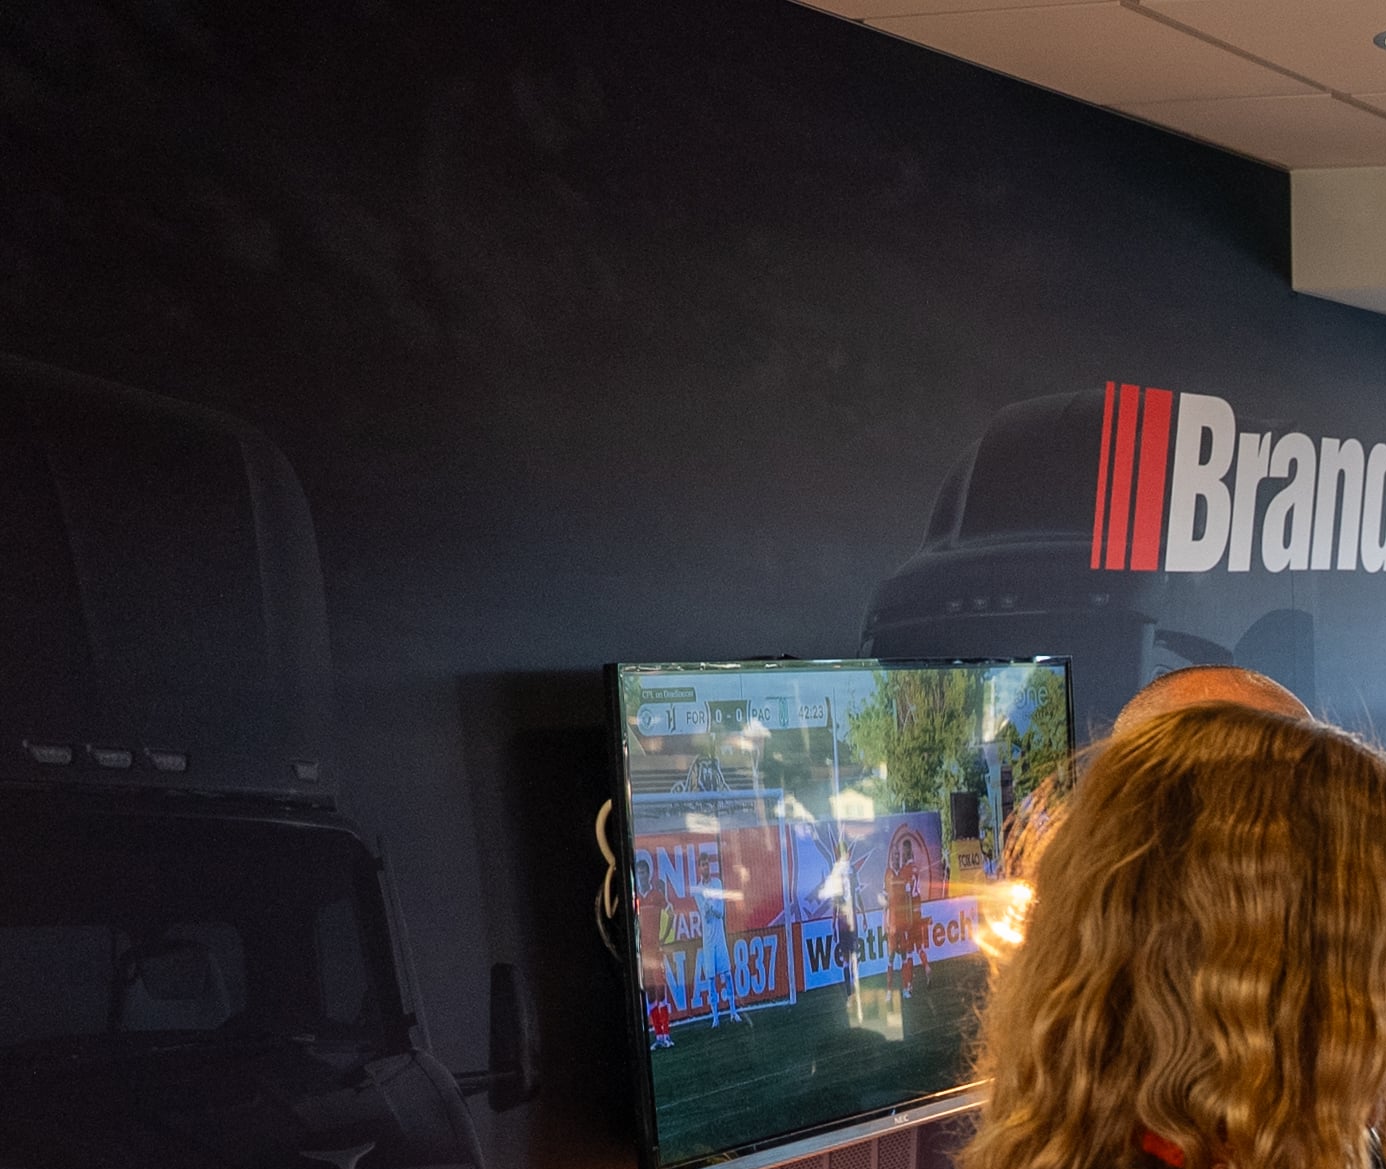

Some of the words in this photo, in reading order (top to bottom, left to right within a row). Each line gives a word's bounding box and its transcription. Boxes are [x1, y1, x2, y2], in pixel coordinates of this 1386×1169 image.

[686, 711, 705, 724] FOR
[752, 708, 770, 722] PAC
[734, 935, 778, 998] 837
